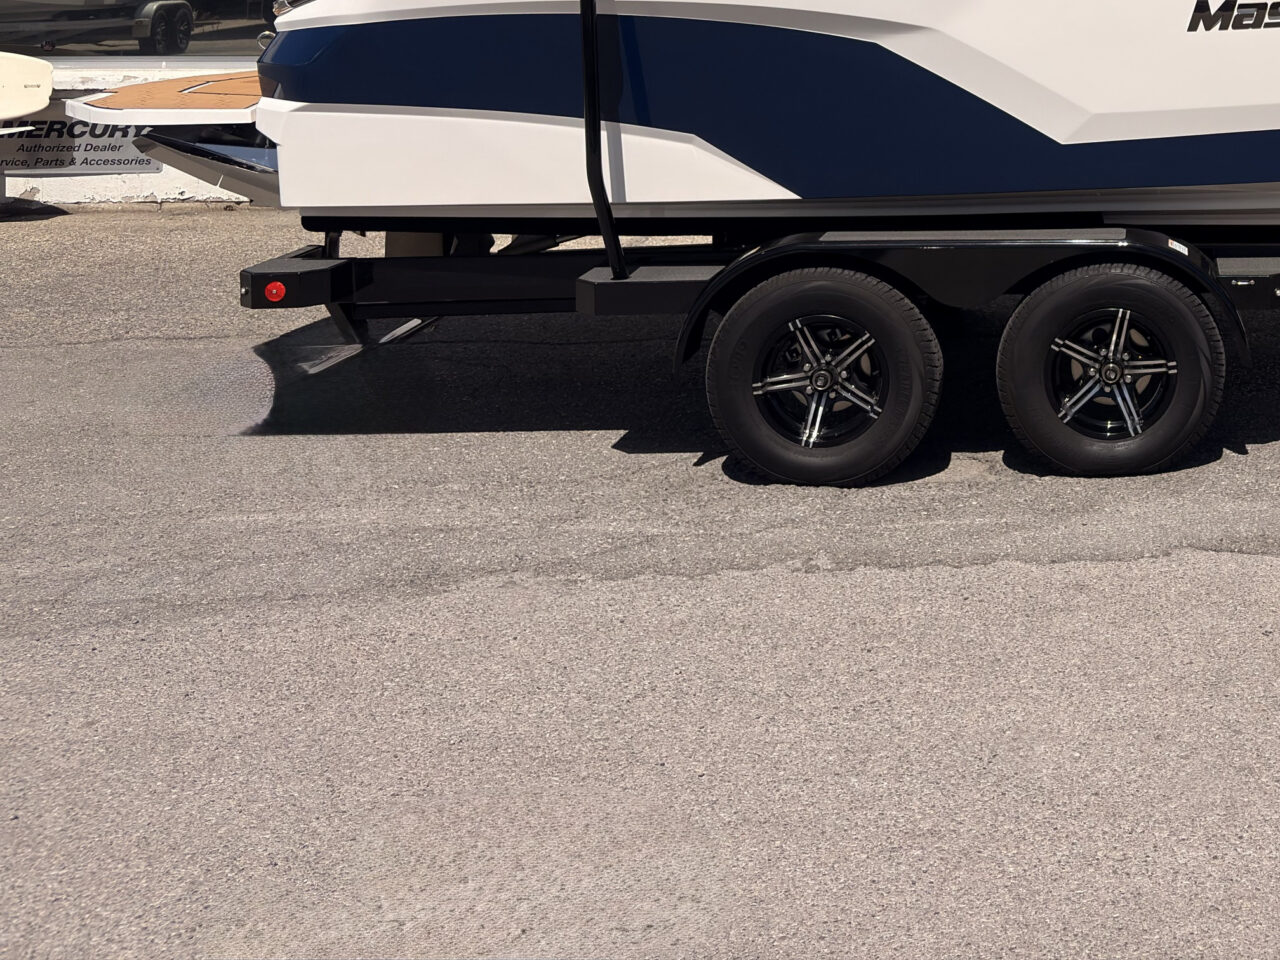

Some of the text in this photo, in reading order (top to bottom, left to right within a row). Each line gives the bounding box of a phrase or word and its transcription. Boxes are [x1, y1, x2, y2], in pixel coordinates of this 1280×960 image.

[16, 142, 124, 153] Authorized Dealer
[34, 157, 65, 167] Parts
[69, 157, 77, 167] &
[80, 156, 152, 167] Accessories
